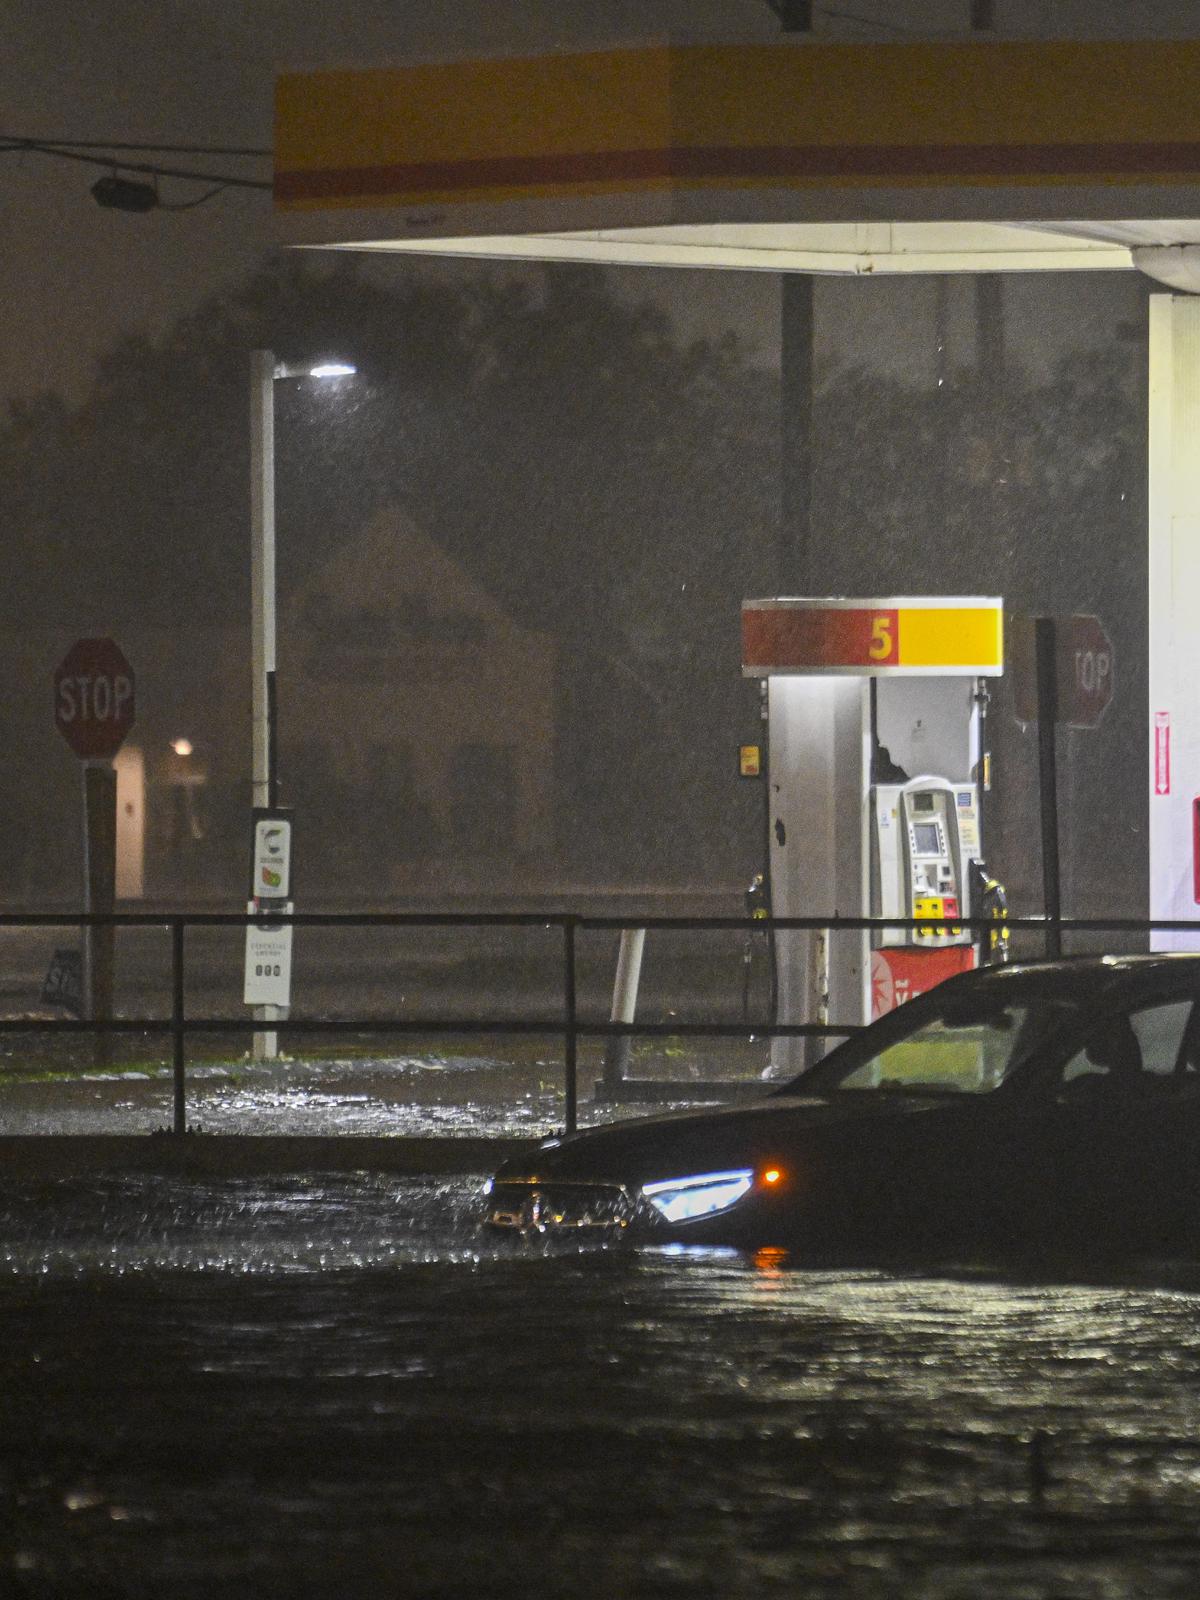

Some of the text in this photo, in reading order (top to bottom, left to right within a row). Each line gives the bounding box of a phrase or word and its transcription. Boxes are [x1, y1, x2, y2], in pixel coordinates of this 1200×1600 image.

[869, 618, 893, 660] 5
[1074, 651, 1110, 691] TOP
[59, 675, 132, 721] STOP
